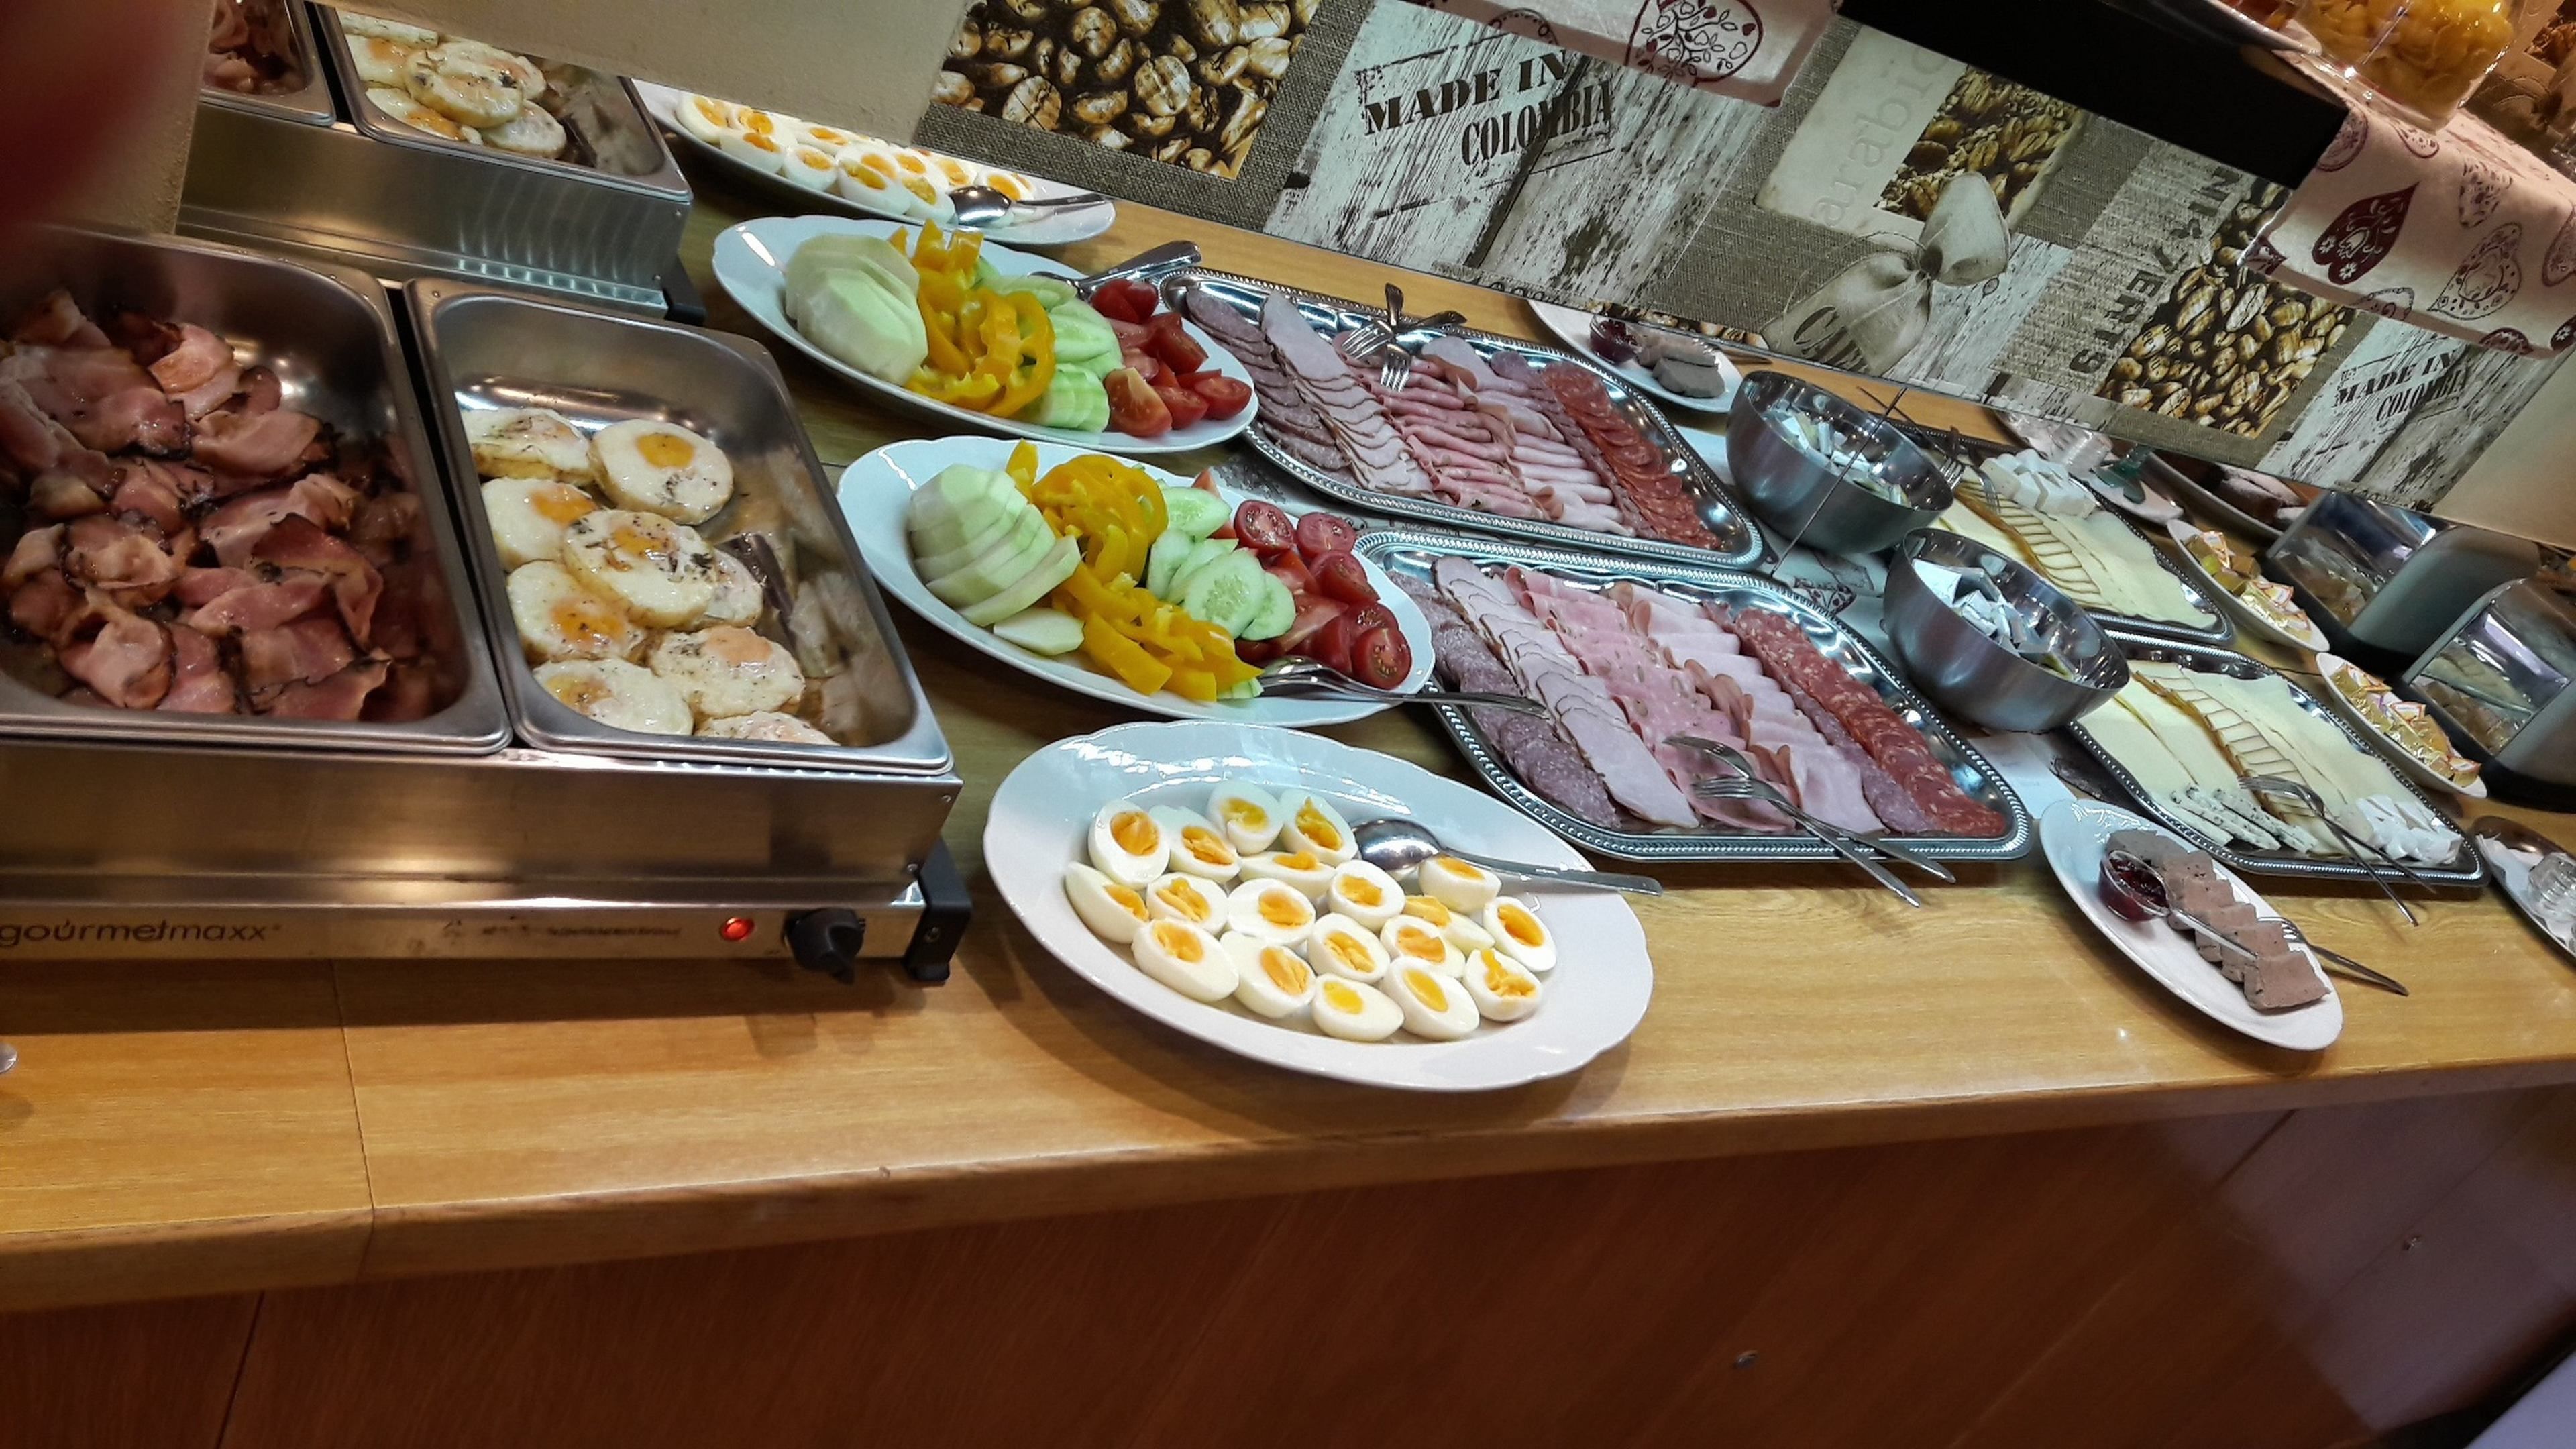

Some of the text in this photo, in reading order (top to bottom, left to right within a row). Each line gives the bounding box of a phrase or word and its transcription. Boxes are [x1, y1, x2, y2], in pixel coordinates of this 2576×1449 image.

[1364, 49, 1568, 136] MADE IN
[1461, 81, 1614, 166] COLOMBIA
[2332, 348, 2458, 407] MADE IN
